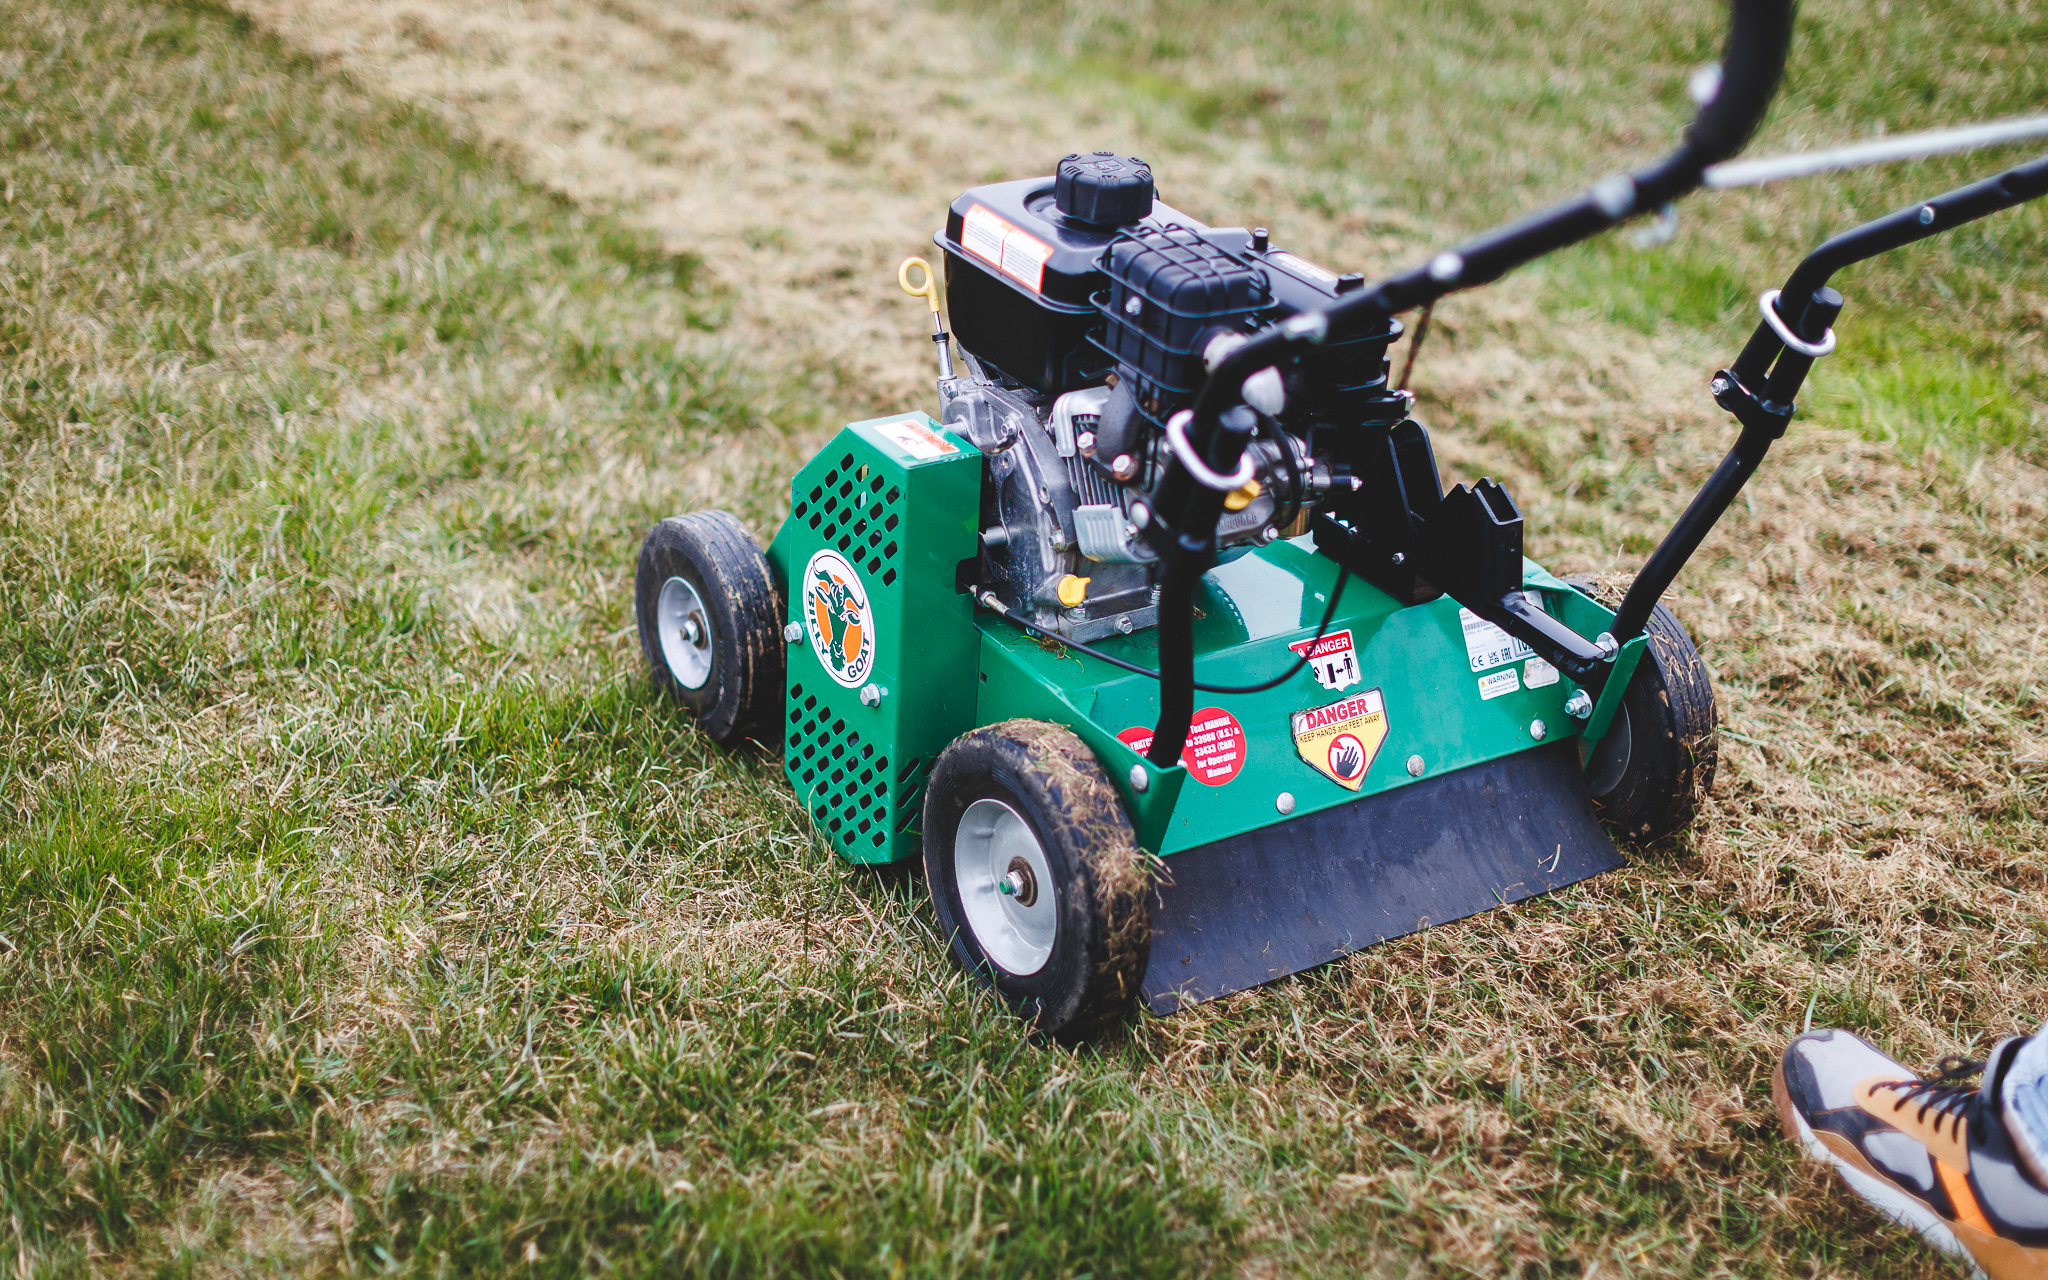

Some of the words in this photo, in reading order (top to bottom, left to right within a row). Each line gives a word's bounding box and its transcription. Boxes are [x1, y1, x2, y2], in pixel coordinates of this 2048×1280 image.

[1217, 512, 1257, 531] ANGUARD
[808, 590, 829, 655] BILLY
[847, 631, 870, 678] GOAT
[1487, 671, 1516, 685] WARNING
[1305, 698, 1368, 730] DANGER
[1190, 723, 1205, 734] Text
[1204, 716, 1231, 730] MANUAL
[1299, 732, 1315, 743] KEEP
[1315, 725, 1337, 739] HANDS
[1337, 724, 1348, 733] and
[1348, 718, 1363, 730] FEET
[1364, 713, 1380, 724] AWAY
[1185, 739, 1193, 748] to
[1234, 727, 1240, 735] &
[1194, 743, 1217, 757] 33433
[1217, 738, 1235, 752] (CAN)
[1196, 759, 1208, 769] for
[1207, 751, 1237, 766] Operator
[1206, 763, 1232, 778] Manual
